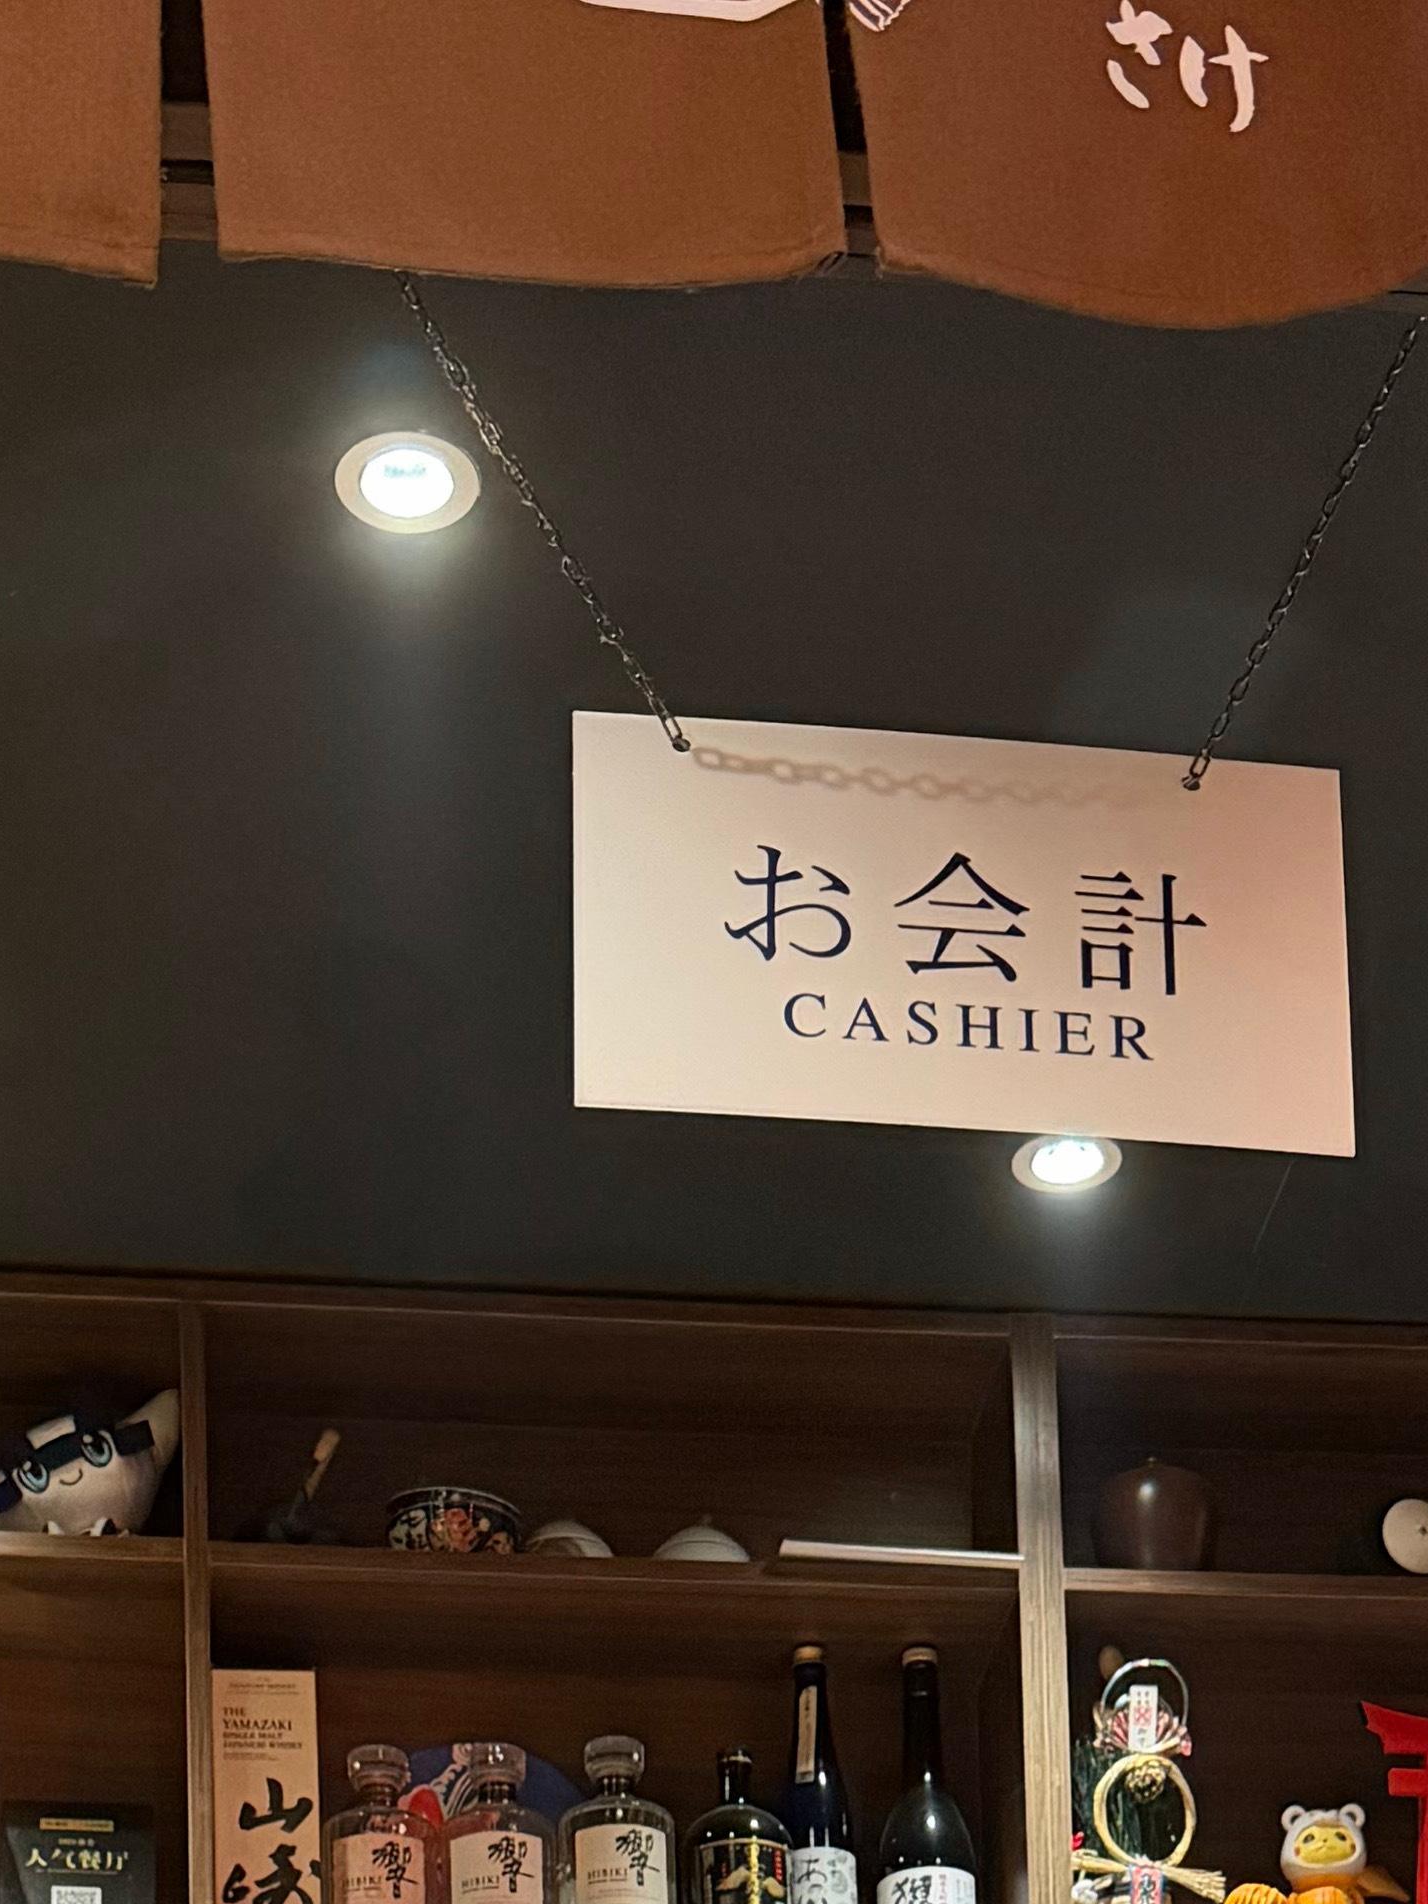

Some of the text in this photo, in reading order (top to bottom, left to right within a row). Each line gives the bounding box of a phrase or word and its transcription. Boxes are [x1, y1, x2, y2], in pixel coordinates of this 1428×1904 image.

[1105, 0, 1270, 133] さけ
[723, 845, 1207, 996] お会計
[783, 993, 1154, 1062] CASHIER
[222, 1706, 246, 1717] THE
[222, 1718, 292, 1731] YAMAZAKI
[586, 1867, 629, 1881] HIBIKI
[341, 1875, 383, 1890] HIBIKI
[461, 1875, 501, 1891] HIBIKI
